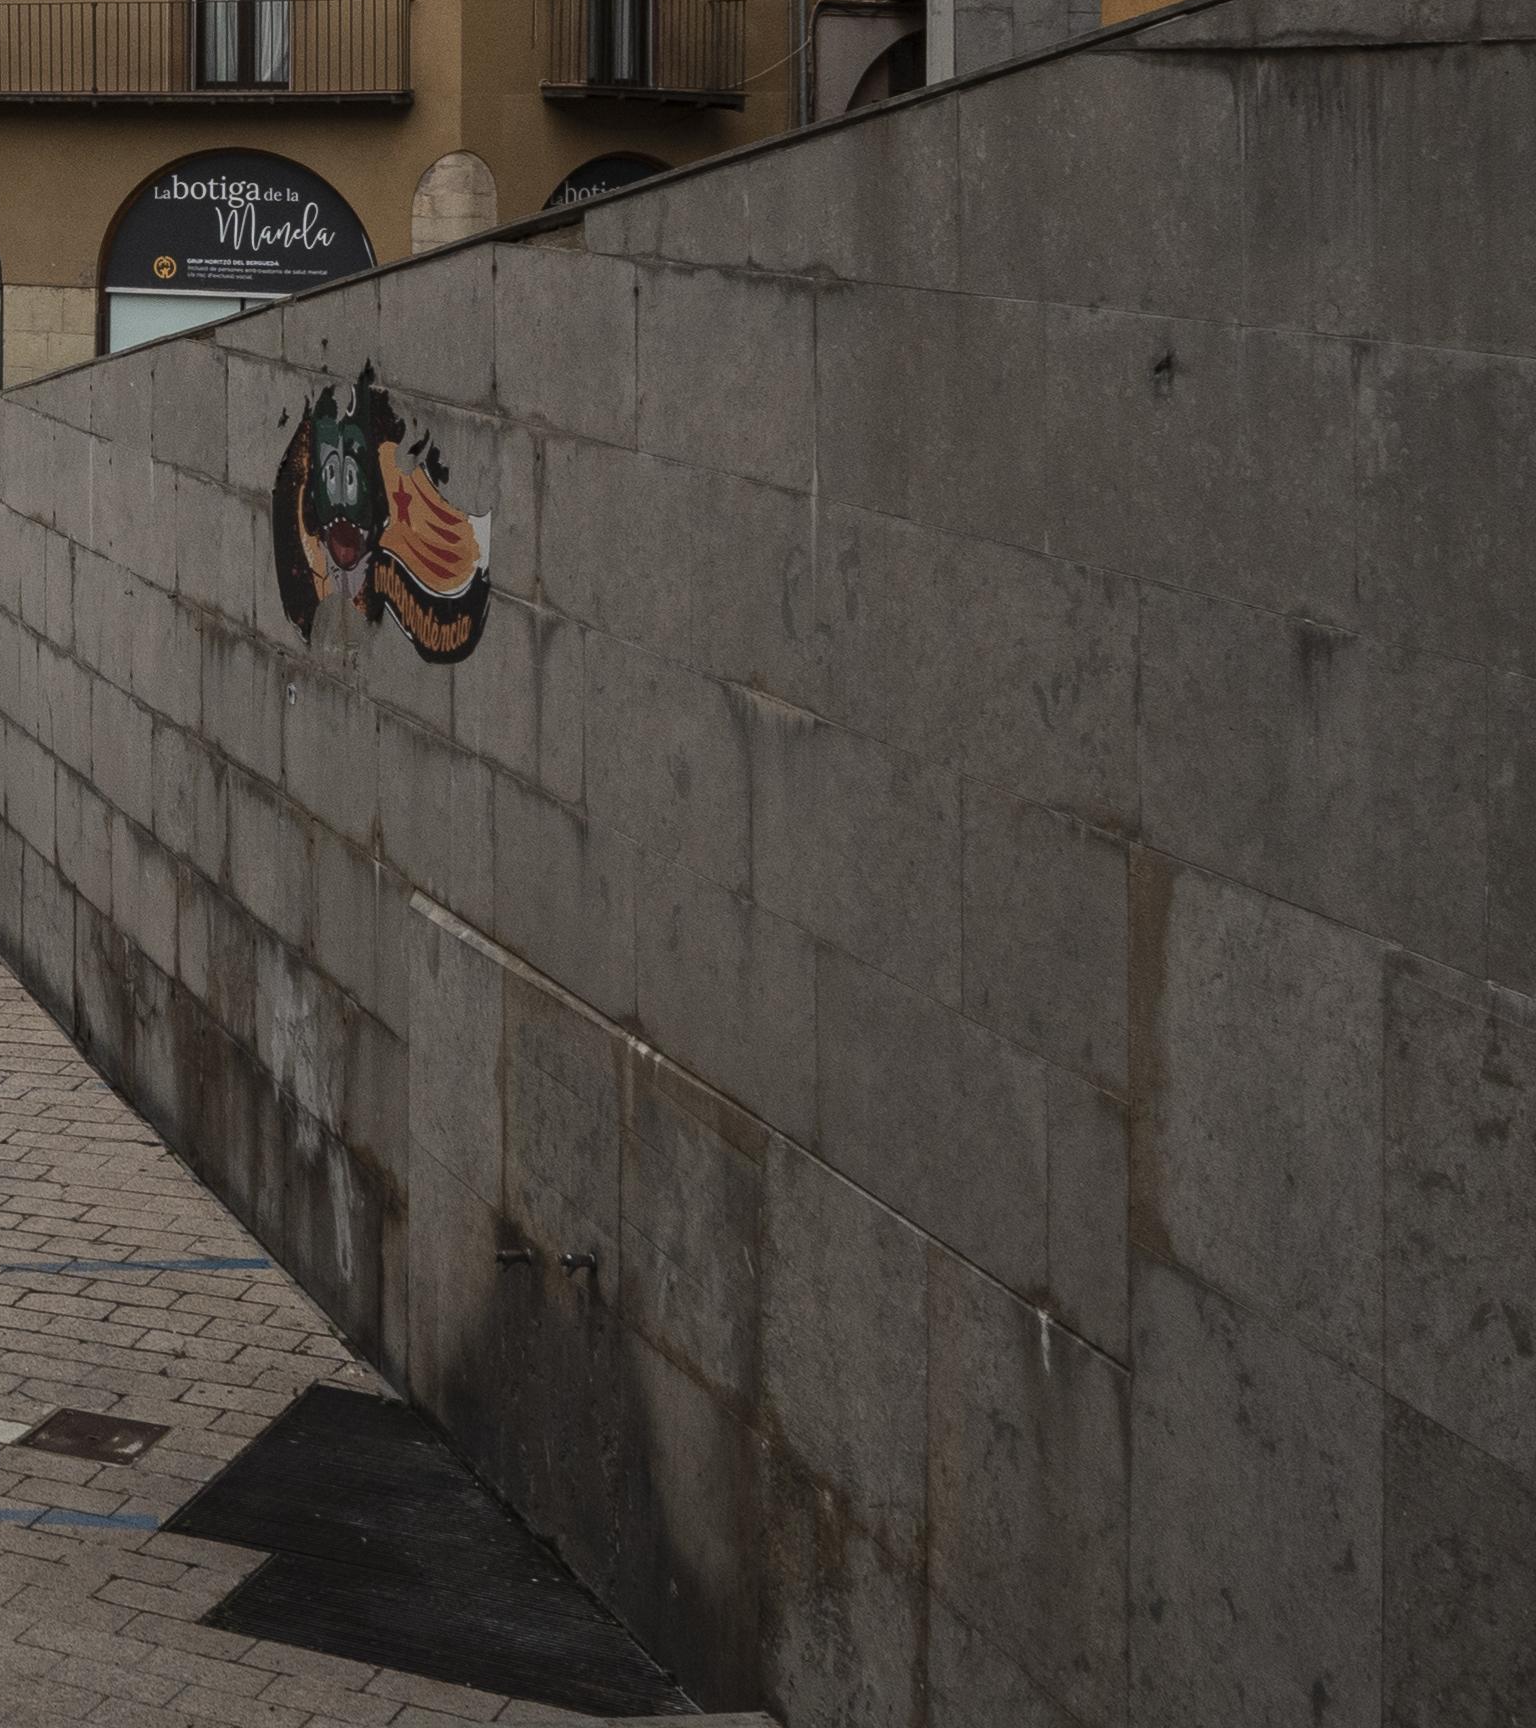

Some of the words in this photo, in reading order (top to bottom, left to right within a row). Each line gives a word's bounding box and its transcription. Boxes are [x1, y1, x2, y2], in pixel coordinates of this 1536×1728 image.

[154, 186, 171, 200] La
[172, 175, 261, 208] botiga
[264, 188, 282, 201] de
[286, 188, 299, 201] la
[215, 202, 335, 251] Manela
